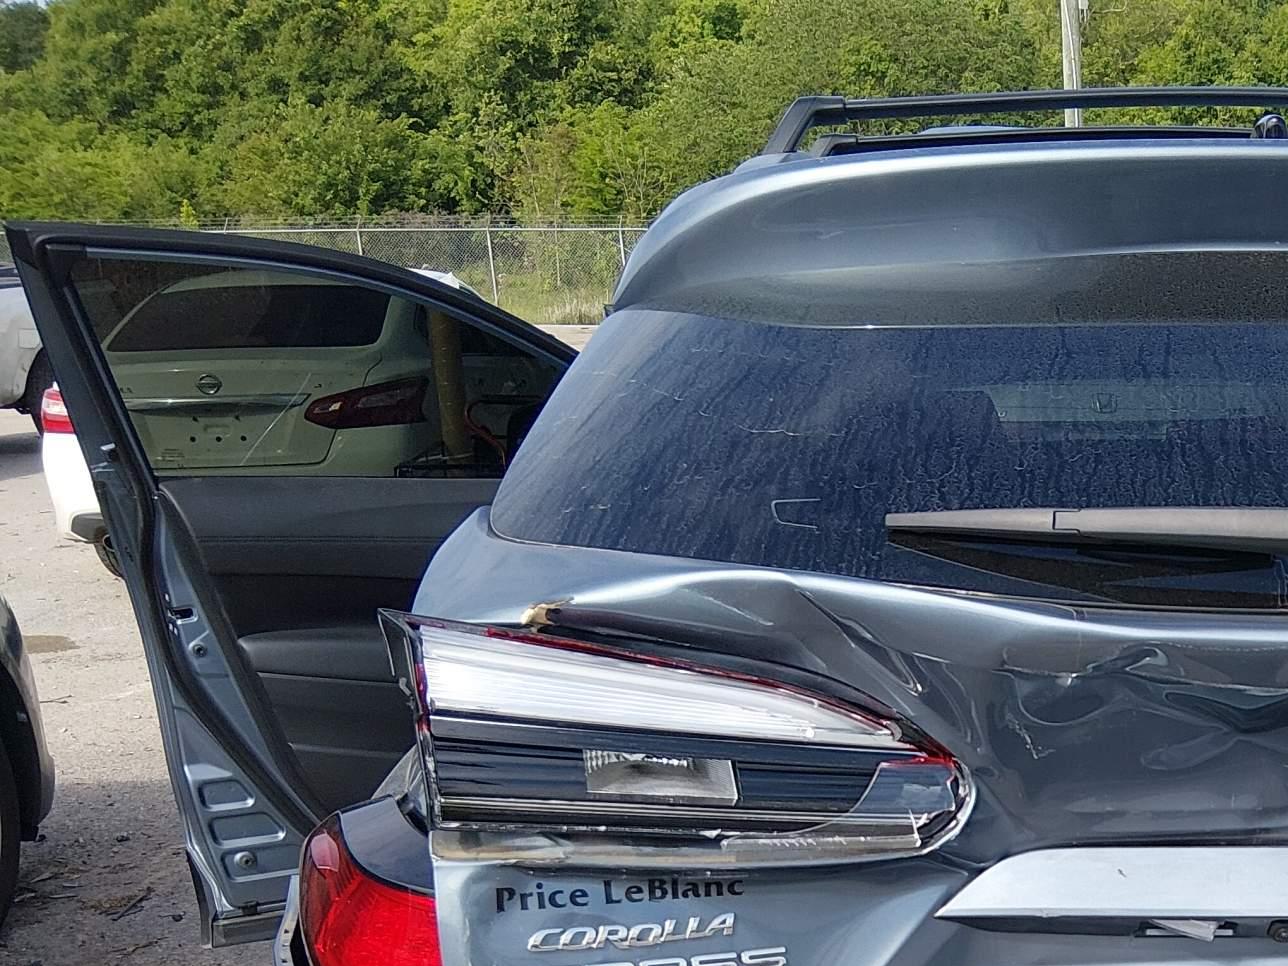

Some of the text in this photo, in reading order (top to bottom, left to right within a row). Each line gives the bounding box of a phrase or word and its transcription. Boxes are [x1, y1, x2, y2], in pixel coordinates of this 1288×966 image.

[496, 878, 745, 913] Price LeBlanc
[527, 912, 736, 952] COROLLA
